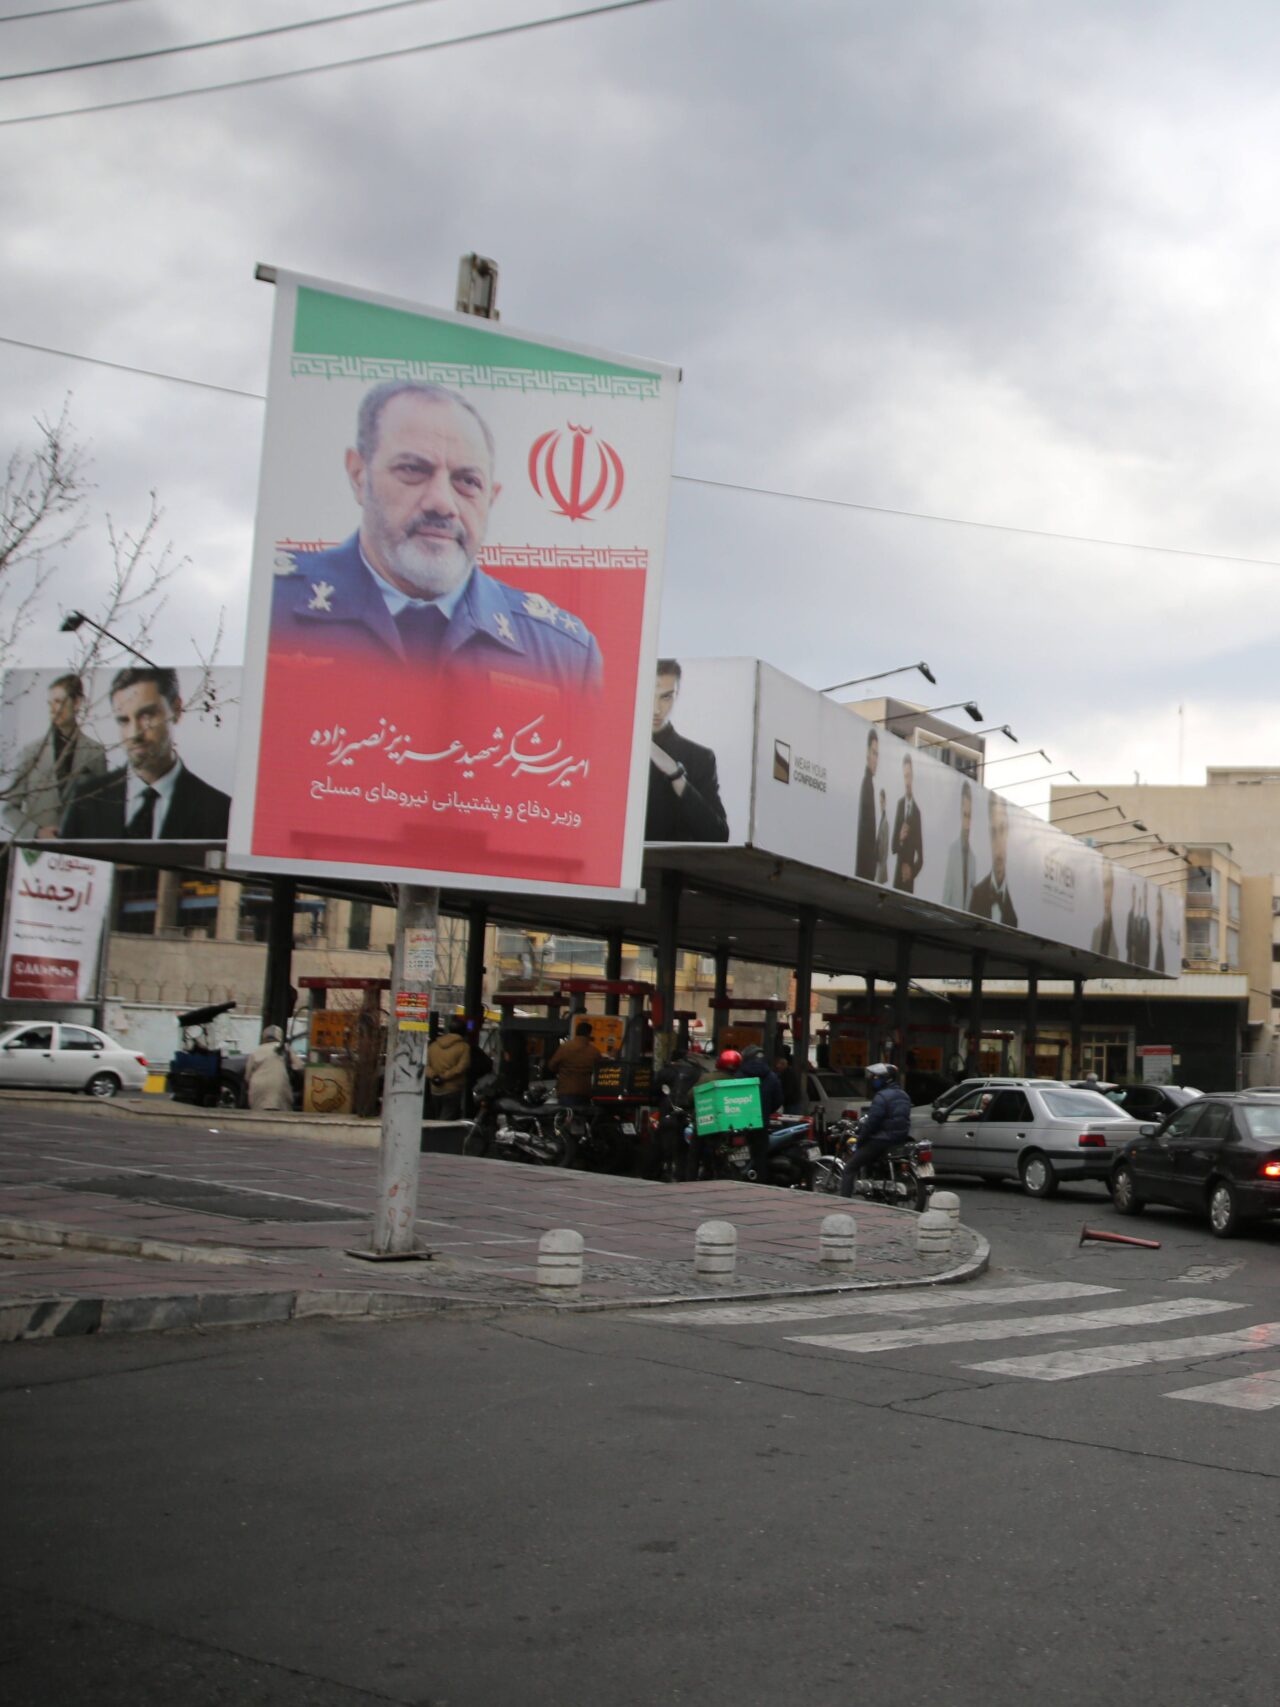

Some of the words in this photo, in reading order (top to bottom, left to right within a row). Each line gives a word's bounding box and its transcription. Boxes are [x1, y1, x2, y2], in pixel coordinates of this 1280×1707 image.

[384, 724, 464, 764] عزیز
[454, 726, 504, 778] شهید
[310, 775, 362, 799] مسلح
[365, 782, 429, 808] نیروهای
[432, 791, 500, 819] پشتیبانی
[504, 803, 513, 819] و
[517, 799, 550, 823] دفاع
[551, 810, 582, 827] وزیر
[47, 853, 96, 875] رستوران
[18, 876, 93, 912] ارجمند
